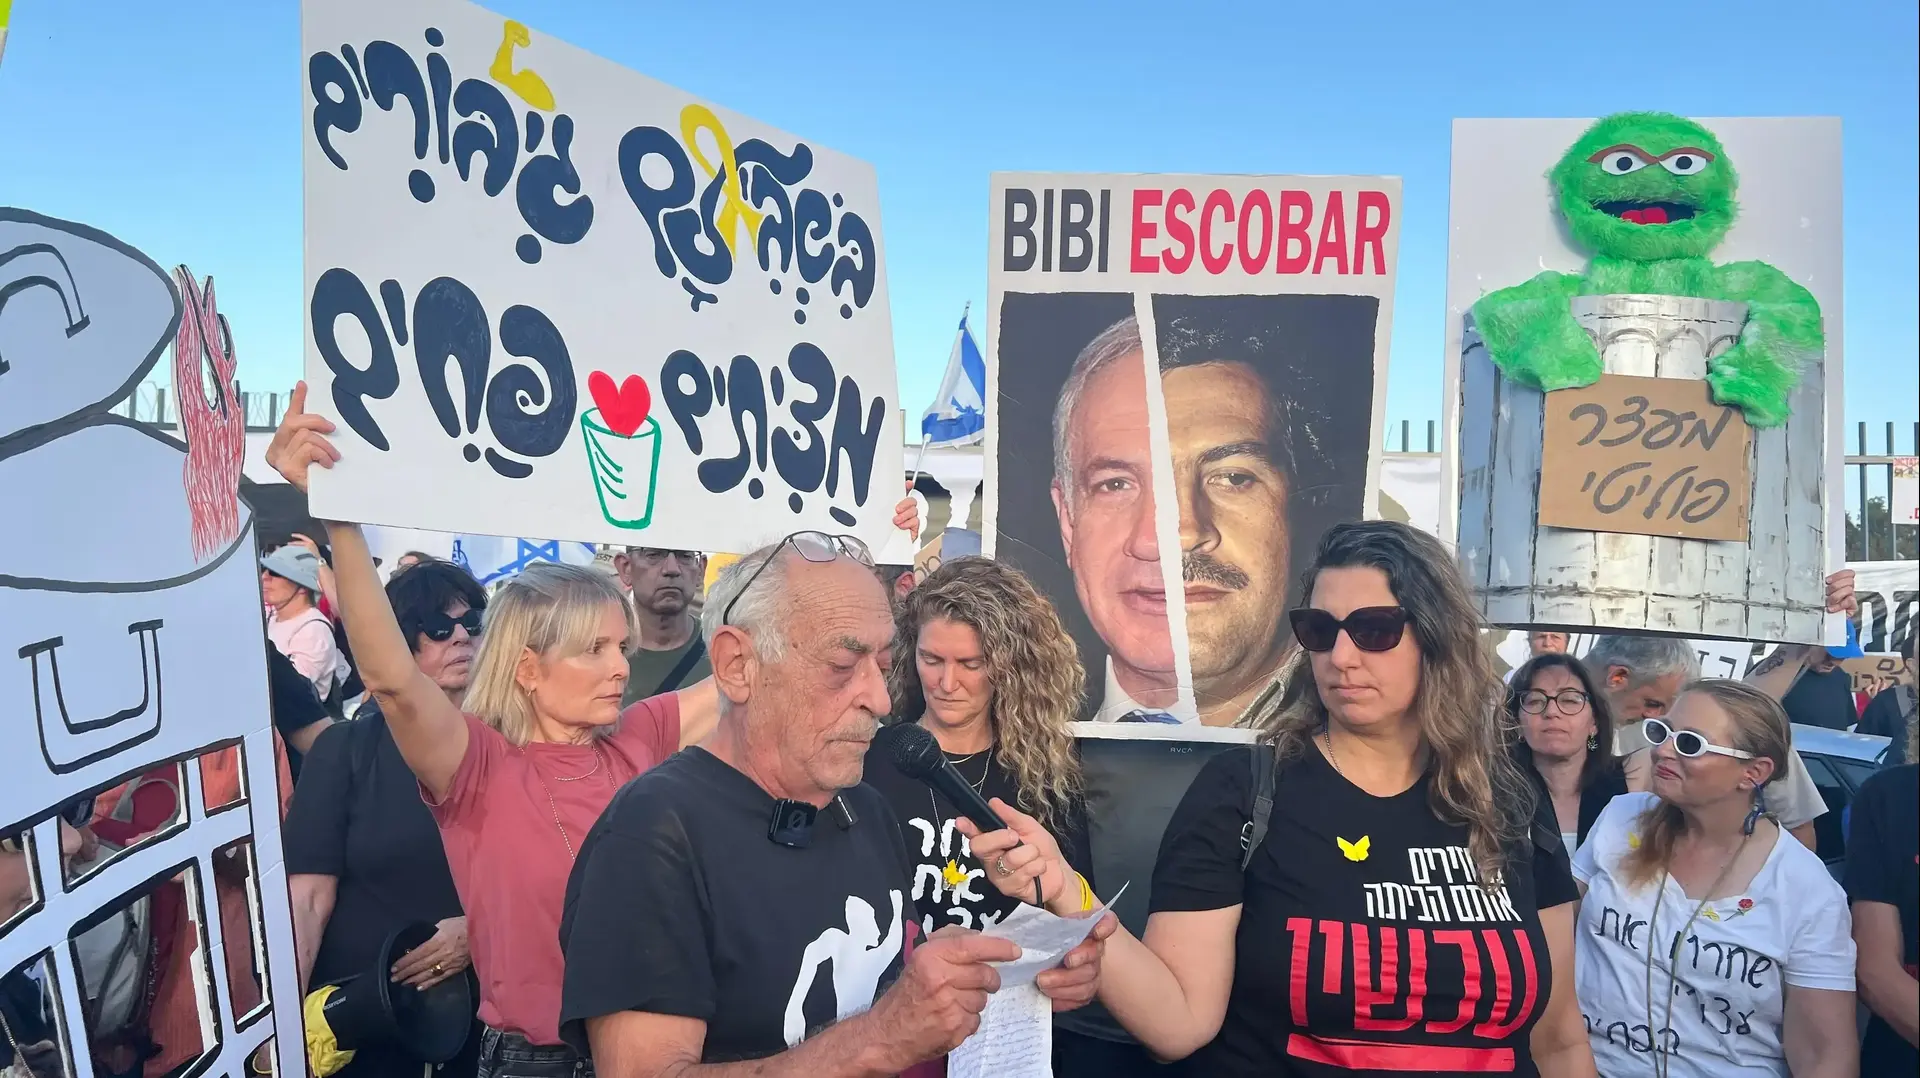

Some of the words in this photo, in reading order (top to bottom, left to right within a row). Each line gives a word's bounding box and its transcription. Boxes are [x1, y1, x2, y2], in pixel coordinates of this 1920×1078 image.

[1003, 188, 1111, 273] BIBI
[1130, 188, 1391, 275] ESCOBAR
[1569, 395, 1733, 451] מעצר
[1580, 461, 1731, 524] פוליטי
[1363, 881, 1452, 922] הביתה
[1449, 884, 1523, 922] אותם
[1594, 905, 1648, 950] את
[1286, 917, 1538, 1040] עכשיו
